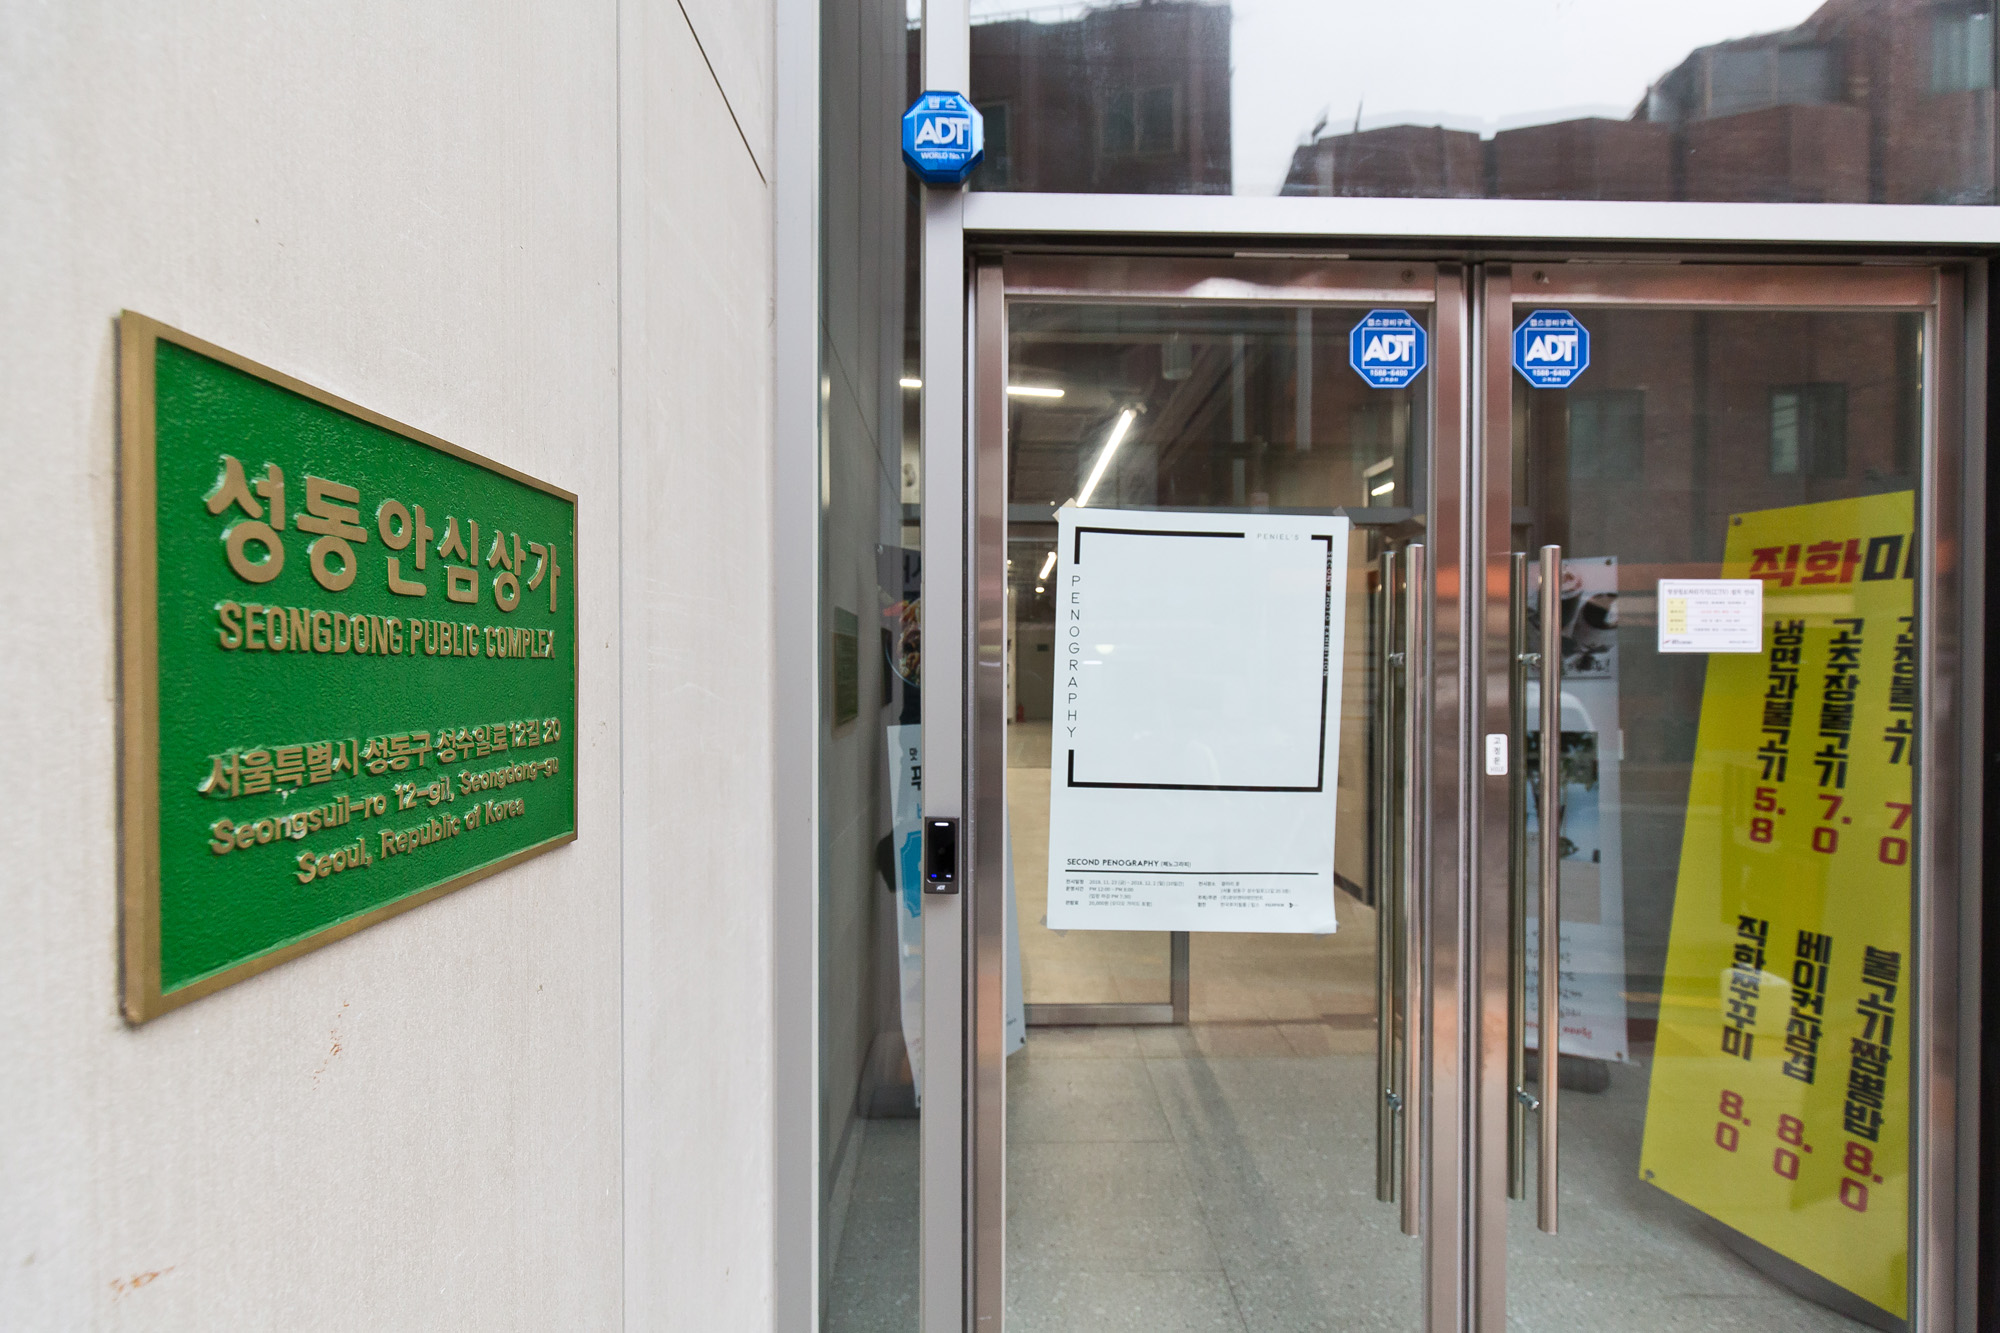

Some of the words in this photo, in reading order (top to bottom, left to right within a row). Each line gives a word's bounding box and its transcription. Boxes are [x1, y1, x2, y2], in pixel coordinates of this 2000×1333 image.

[915, 117, 970, 145] ADT
[1363, 334, 1415, 362] ADT
[1525, 334, 1578, 362] ADT
[1370, 368, 1408, 377] 1588-6400
[1532, 368, 1570, 377] 1588-6400
[205, 455, 561, 613] 성동안심상가
[1257, 533, 1299, 541] PENIEL'S
[215, 600, 403, 655] SEONGDONG
[408, 618, 480, 657] PUBLIC
[484, 624, 556, 659] COMPLEX
[1067, 575, 1081, 738] PENOGRAPHY
[1814, 618, 1865, 789] 고추장불고기
[198, 738, 358, 798] 서울특별시
[362, 731, 432, 776] 성동구
[437, 719, 540, 764] 성수일로12길
[542, 717, 562, 742] 20
[210, 794, 387, 855] Seongsuil-ro
[395, 777, 455, 822] 12-gil,
[459, 757, 560, 798] Seongdong-gu
[297, 838, 372, 884] Seoul,
[380, 813, 461, 858] Republic
[464, 805, 482, 831] of
[483, 798, 525, 826] Korea
[1067, 858, 1100, 866] SECOND
[1102, 859, 1159, 867] PENOGRAPHY
